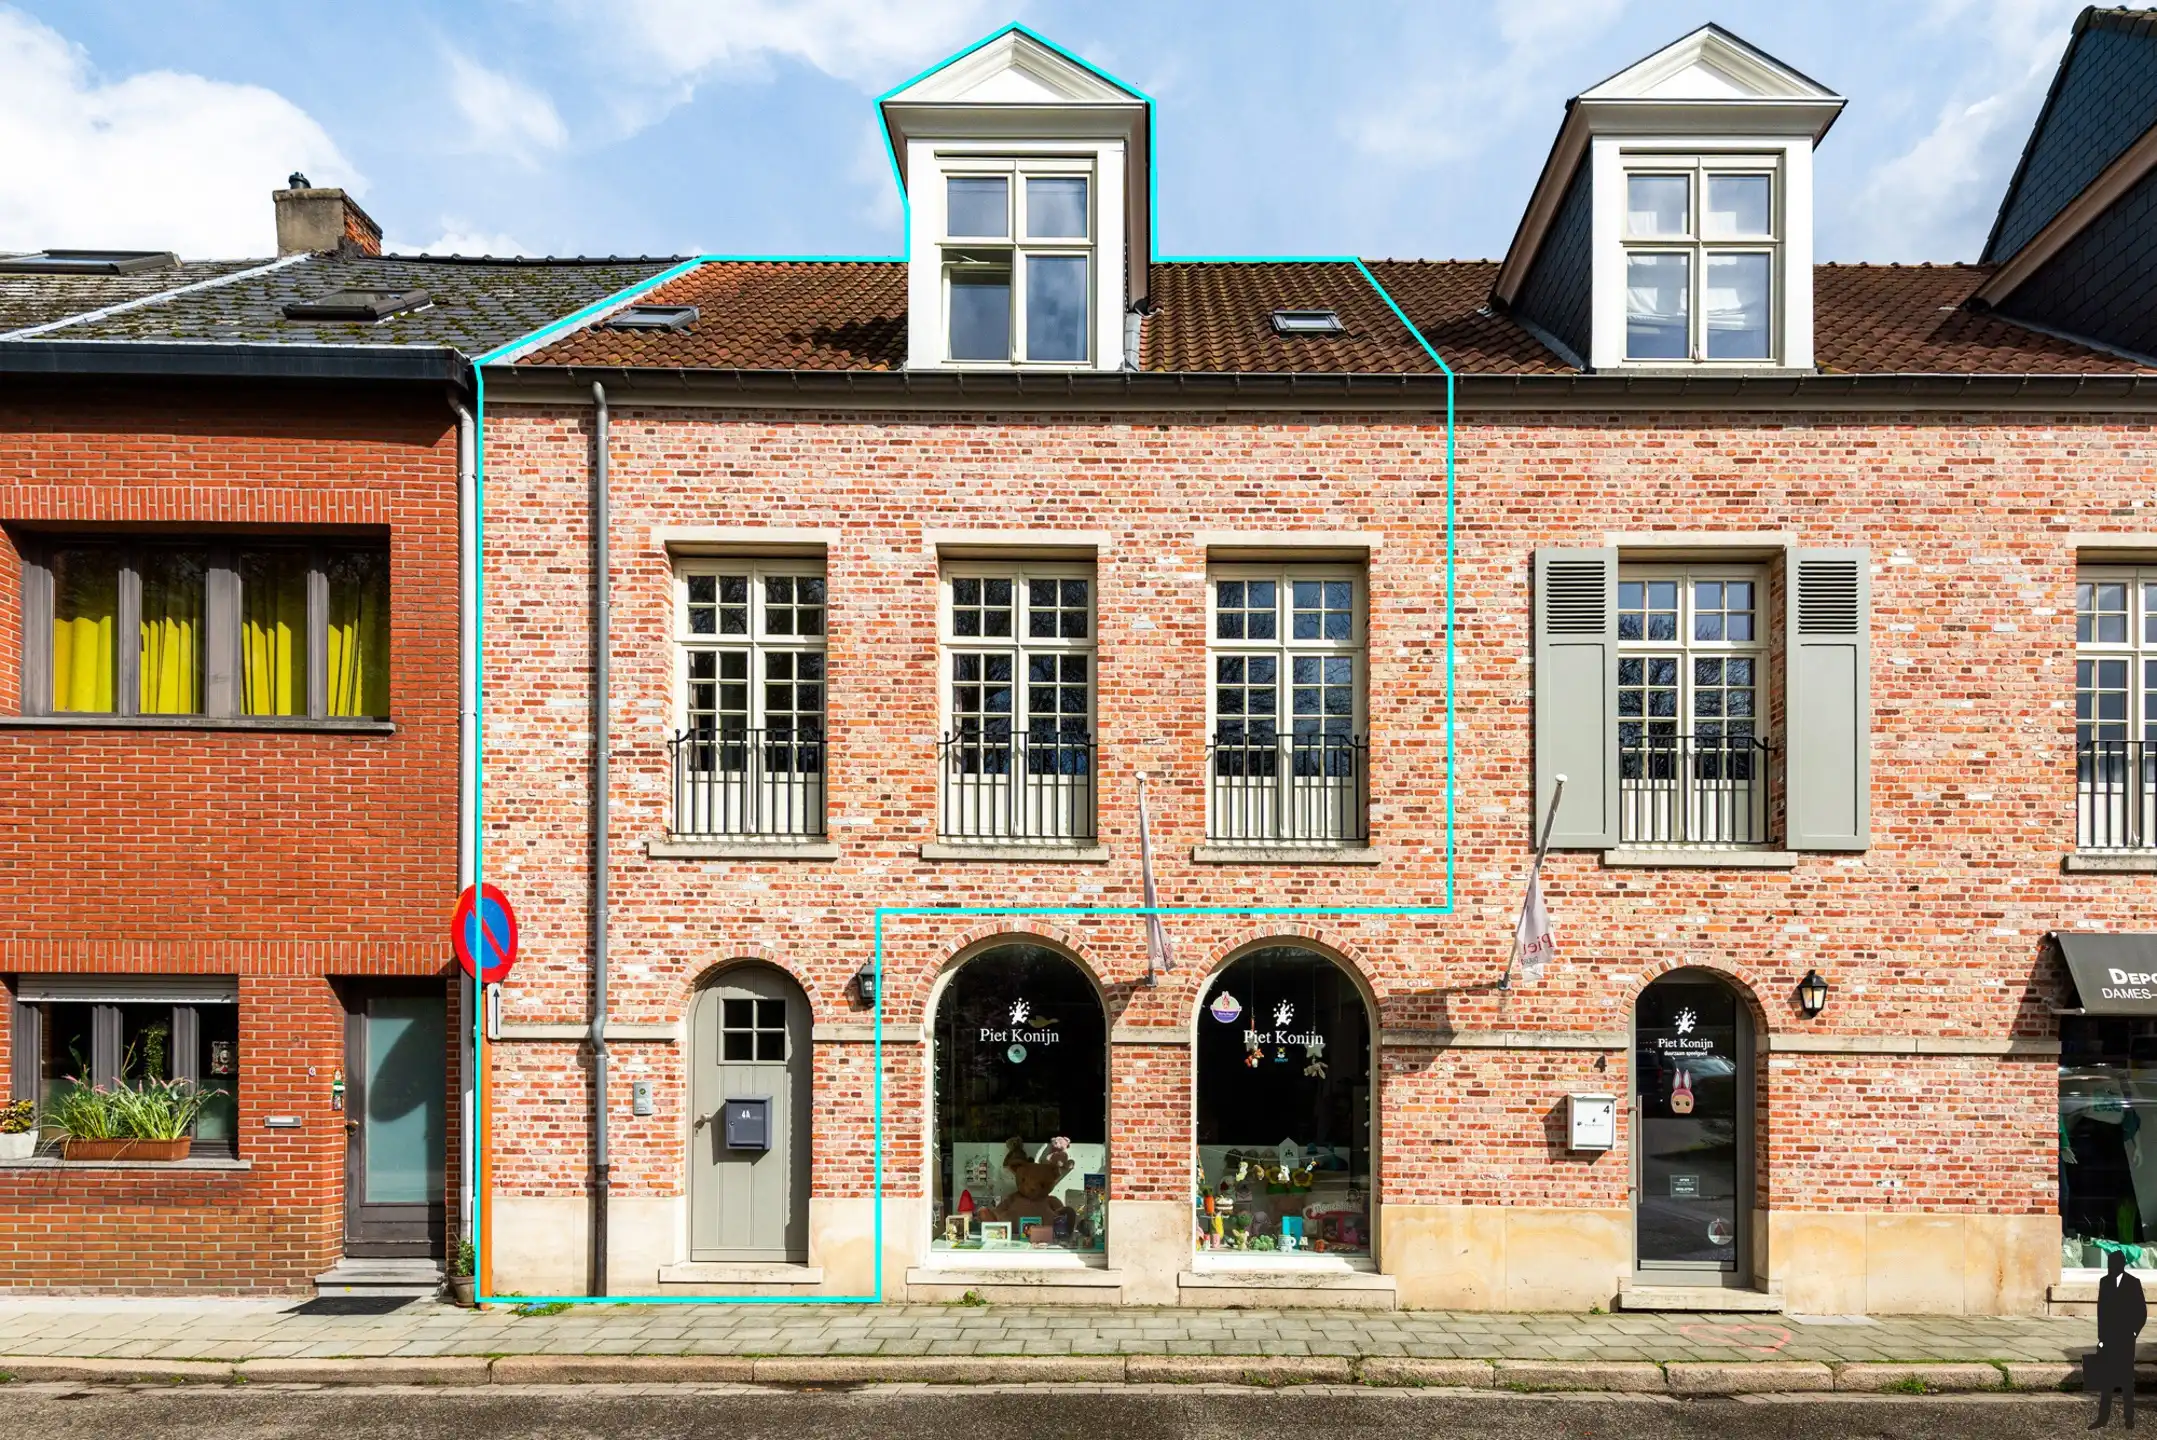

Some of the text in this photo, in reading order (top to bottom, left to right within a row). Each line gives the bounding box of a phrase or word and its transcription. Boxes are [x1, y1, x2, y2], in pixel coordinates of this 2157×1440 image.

[979, 1028, 1060, 1046] Piet Konijn
[1243, 1029, 1324, 1048] Piet Konijn
[1657, 1038, 1714, 1051] Piet Konijn
[741, 1110, 751, 1119] 4A
[1603, 1105, 1610, 1115] 4
